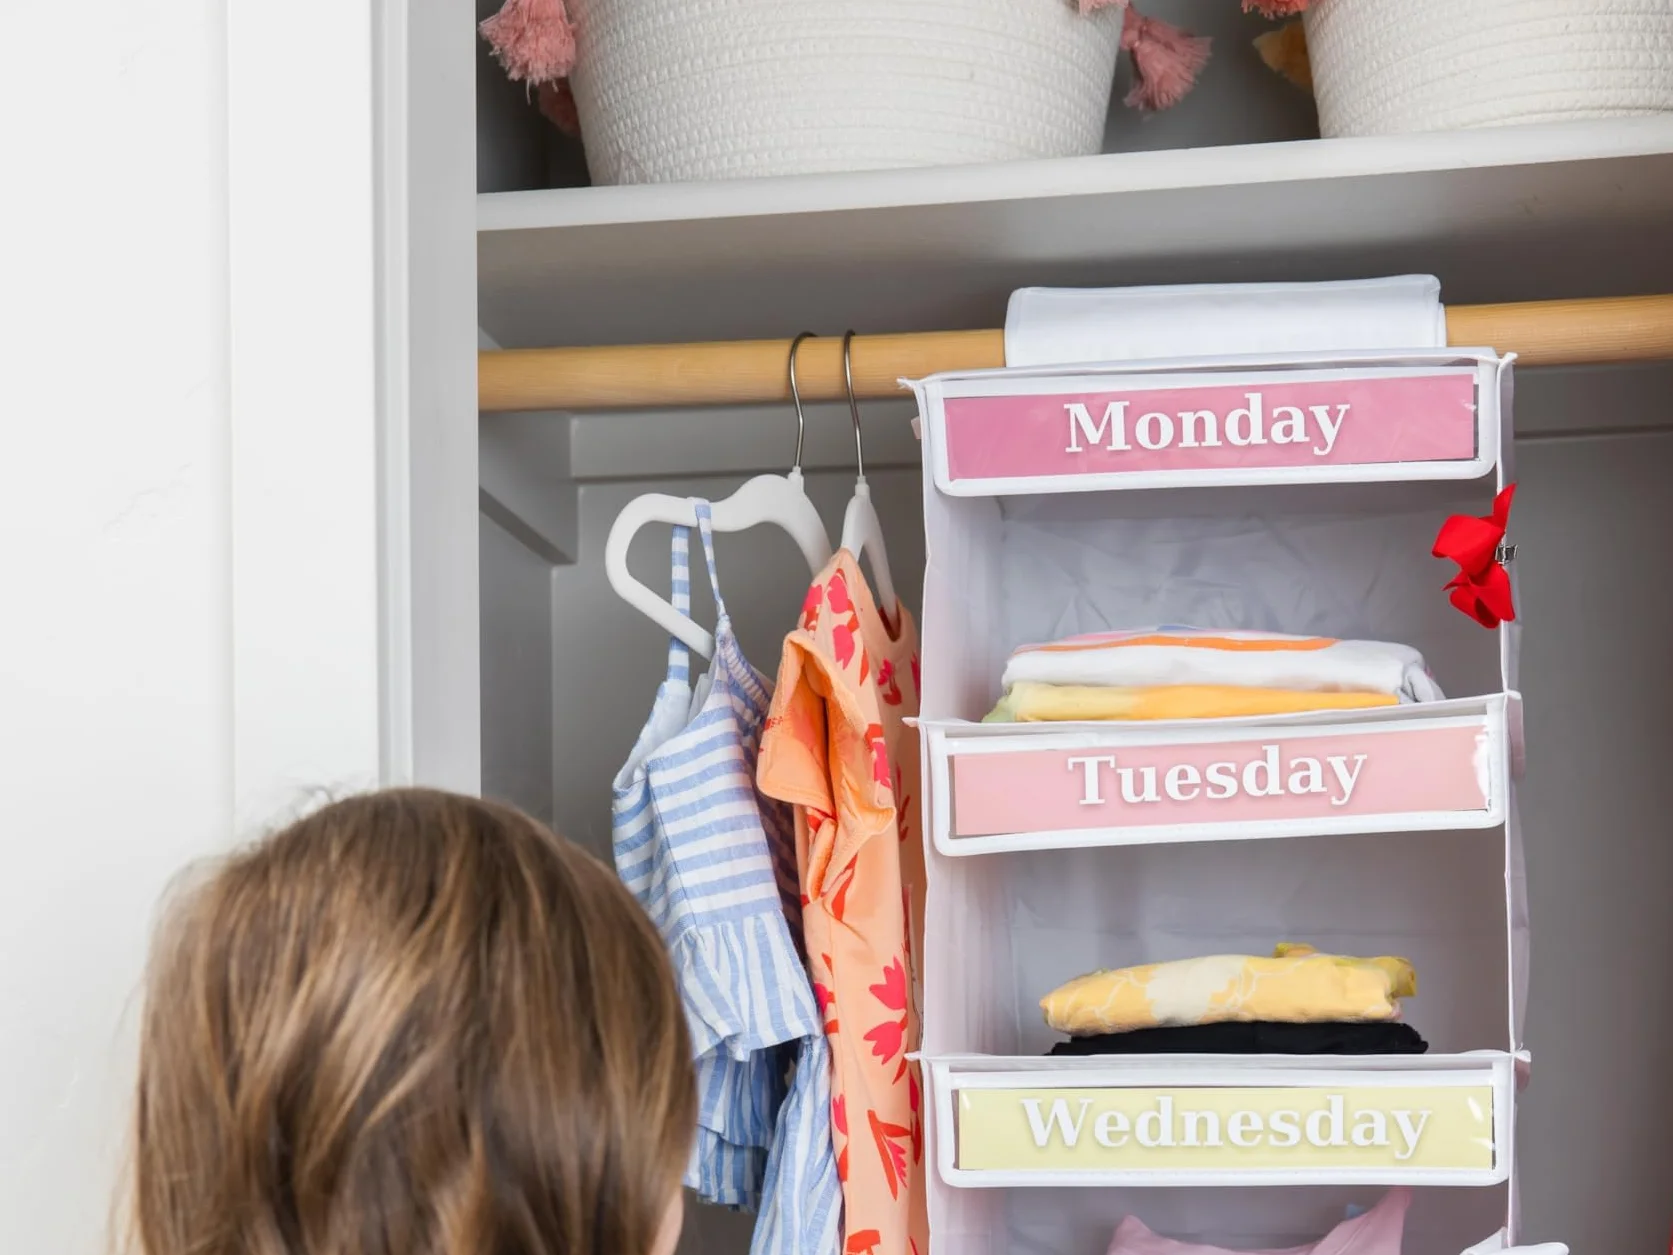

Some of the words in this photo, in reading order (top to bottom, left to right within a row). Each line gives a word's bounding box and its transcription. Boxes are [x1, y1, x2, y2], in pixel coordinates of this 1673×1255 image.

[1063, 393, 1350, 455] Monday
[1067, 745, 1367, 805] Tuesday
[1021, 1096, 1431, 1159] Wednesday
